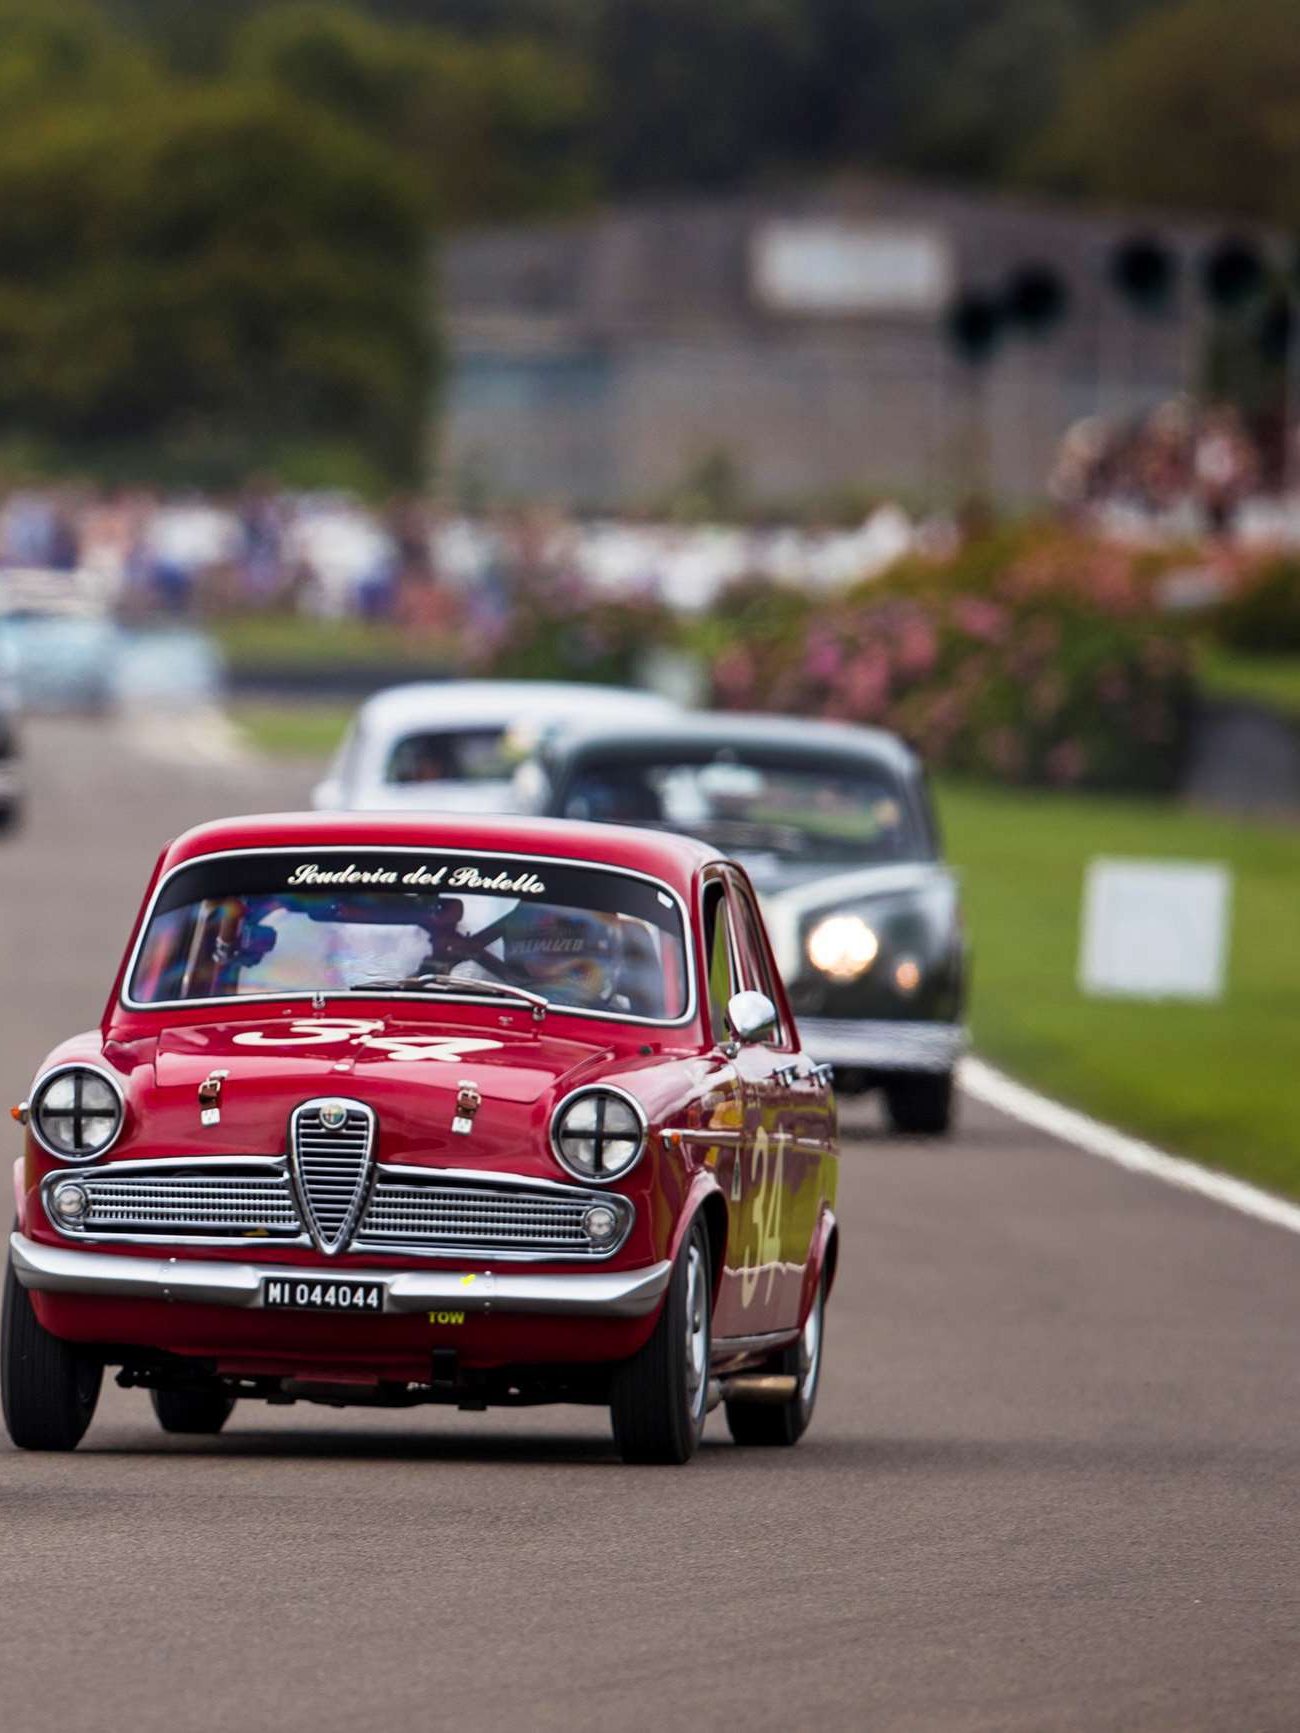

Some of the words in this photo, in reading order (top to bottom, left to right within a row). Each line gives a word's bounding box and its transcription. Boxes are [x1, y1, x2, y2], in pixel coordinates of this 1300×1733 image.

[287, 863, 398, 885] Scuderia
[402, 865, 448, 885] del
[449, 866, 546, 894] Portello
[232, 1018, 504, 1062] 34
[741, 1122, 785, 1310] 34
[268, 1282, 290, 1304] MI
[296, 1284, 380, 1308] 044044
[428, 1311, 465, 1325] TOW
